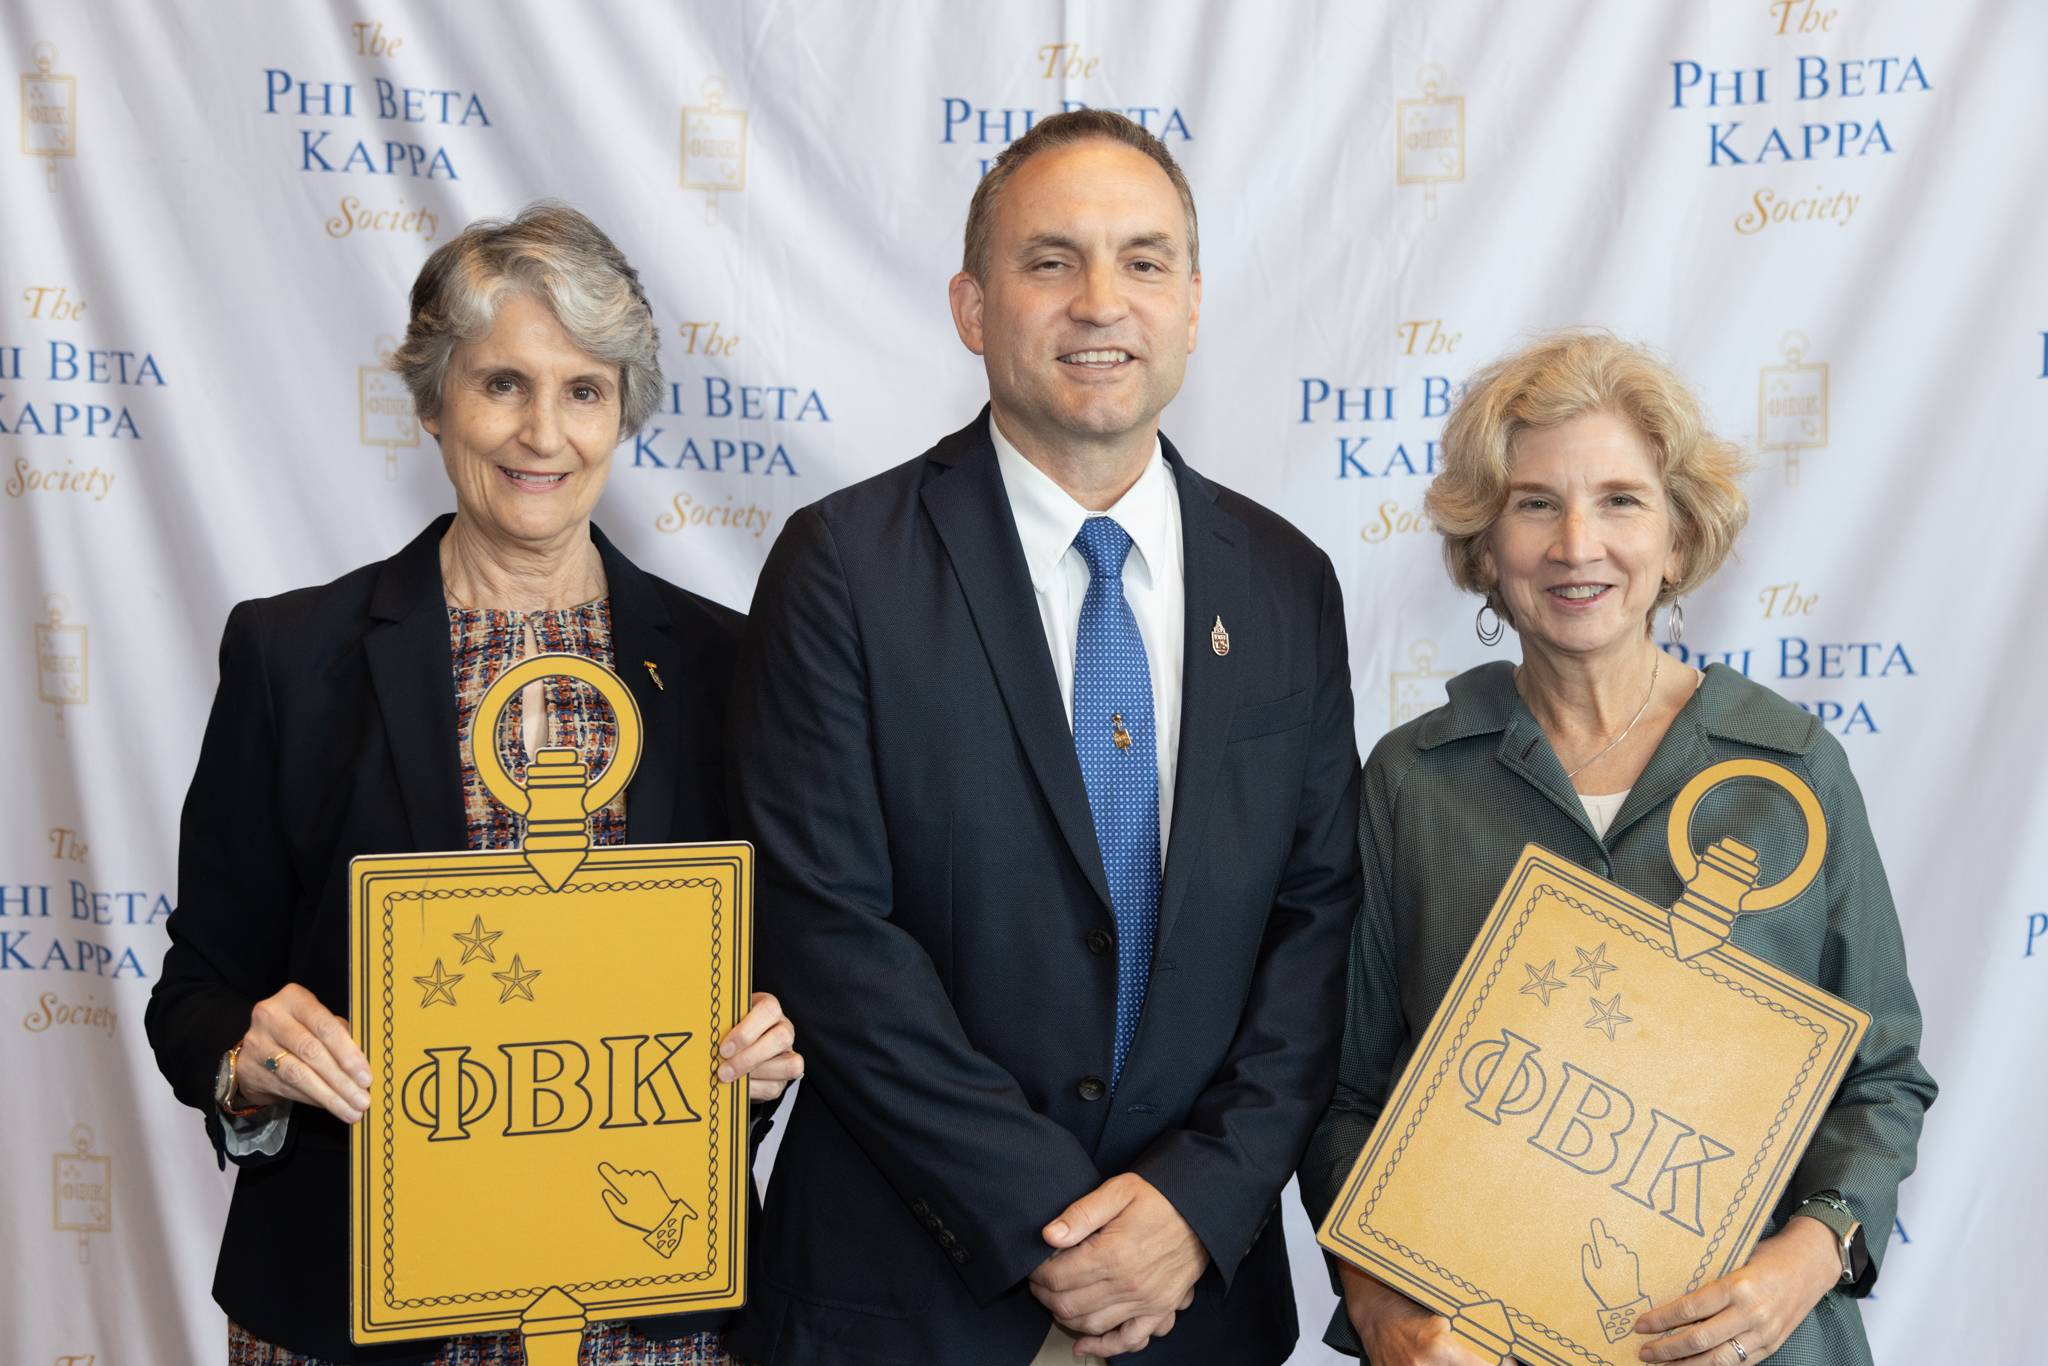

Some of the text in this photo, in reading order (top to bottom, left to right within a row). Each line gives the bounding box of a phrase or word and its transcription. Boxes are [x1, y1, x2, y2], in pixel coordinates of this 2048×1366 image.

[1769, 0, 1838, 36] The
[352, 21, 402, 58] The
[1037, 43, 1099, 80] The
[325, 195, 440, 242] Society
[1733, 185, 1861, 236] Society
[24, 286, 87, 321] The
[679, 321, 741, 357] The
[1397, 319, 1462, 356] The
[0, 393, 142, 440] APPA
[6, 456, 116, 501] Society
[655, 493, 773, 538] Society
[1759, 582, 1820, 619] The
[49, 827, 89, 864] The
[0, 884, 51, 918] HI
[23, 991, 119, 1039] Society
